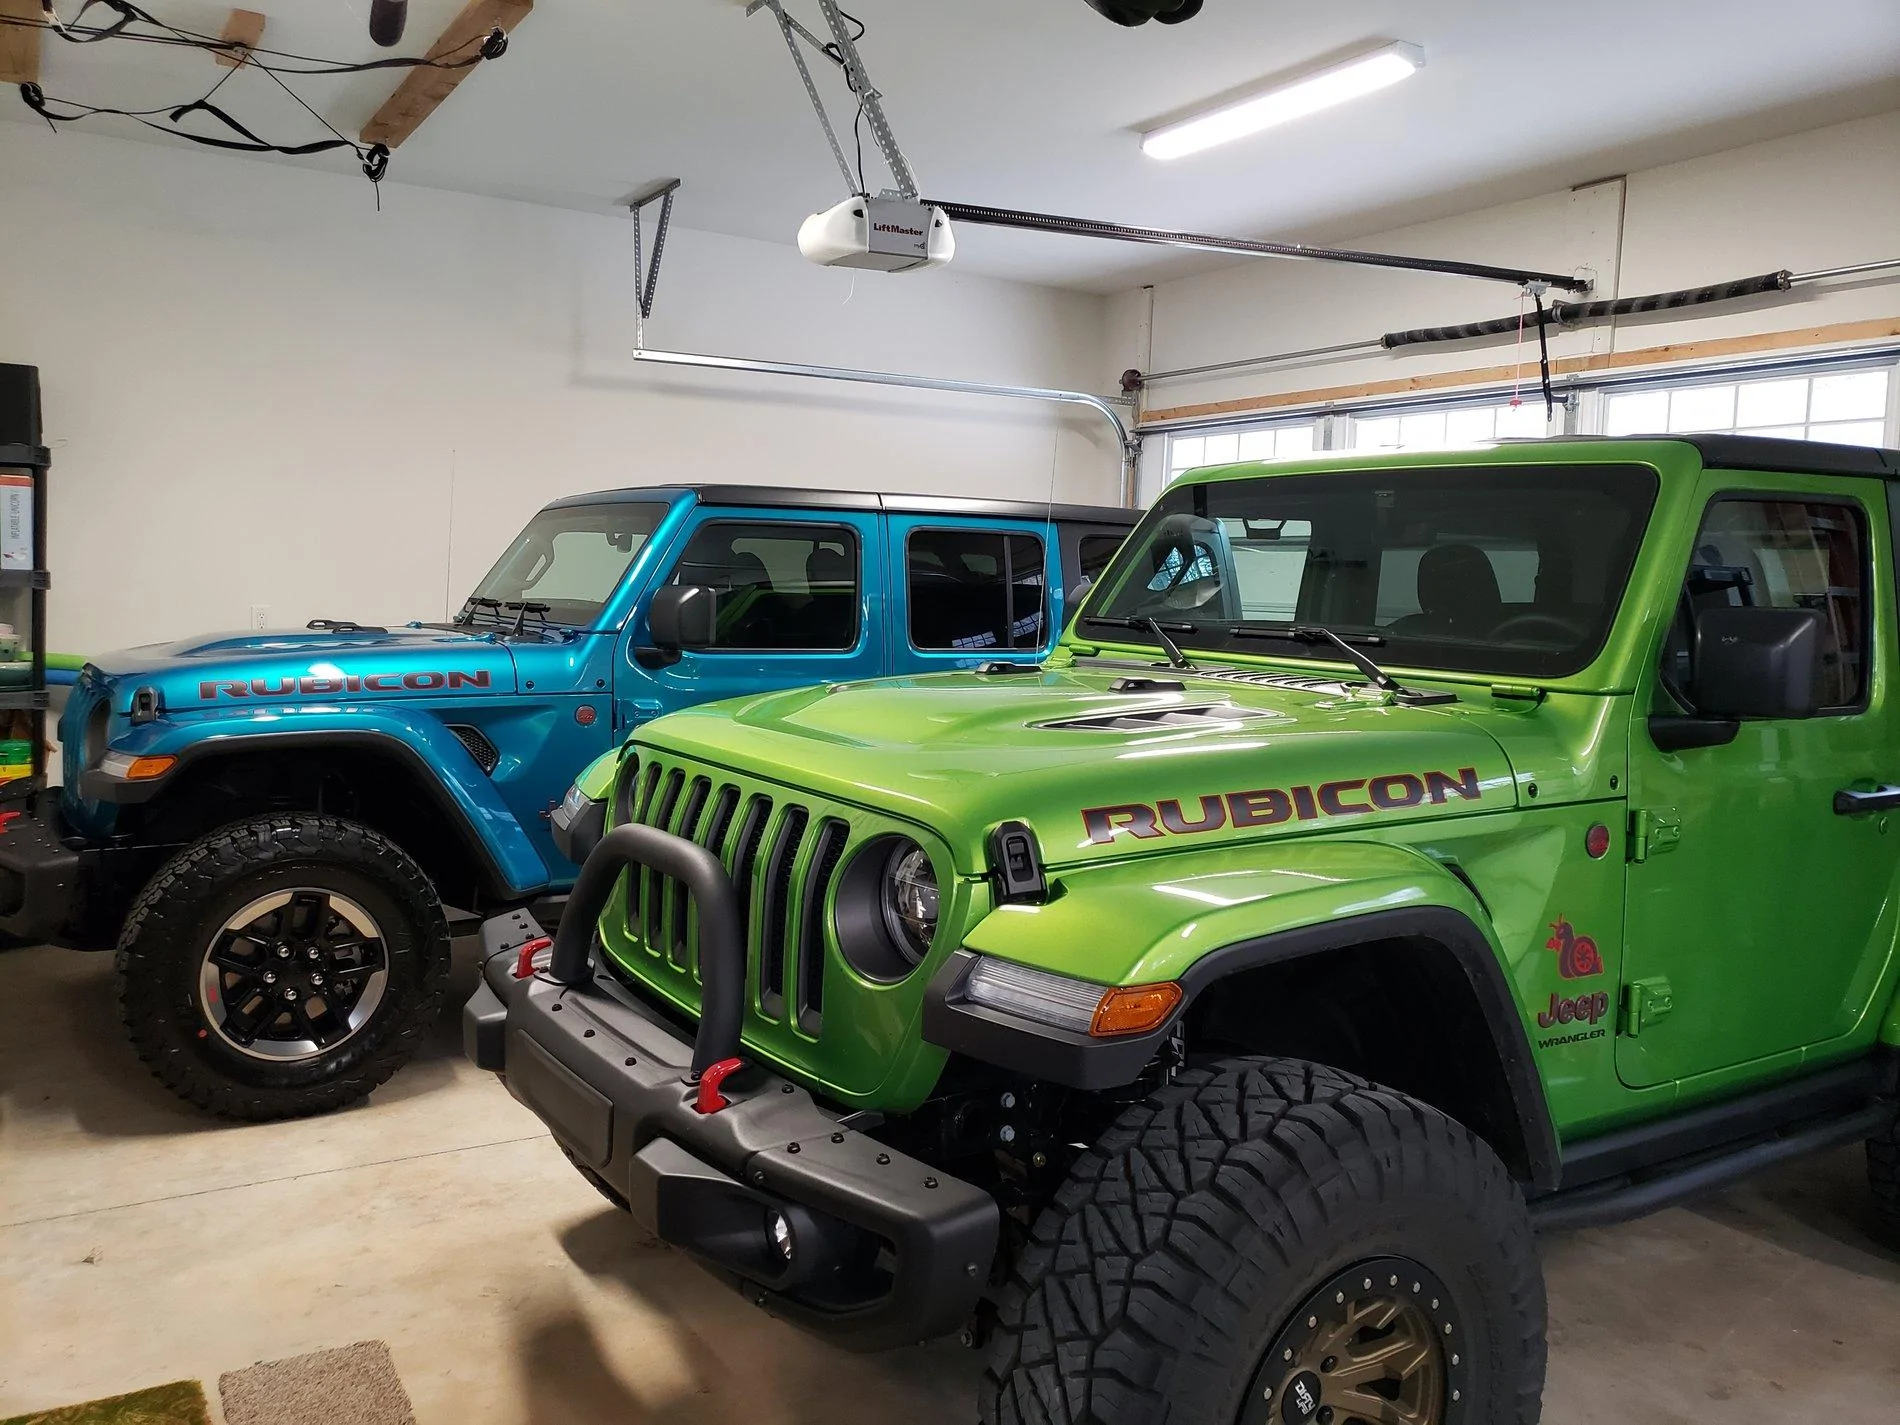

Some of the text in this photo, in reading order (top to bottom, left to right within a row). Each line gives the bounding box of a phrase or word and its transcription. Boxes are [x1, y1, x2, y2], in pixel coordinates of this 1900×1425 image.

[873, 222, 923, 236] LiftMaster
[199, 670, 491, 700] RUBICON
[1081, 767, 1482, 845] RUBICON
[1537, 991, 1610, 1029] Jeep
[1538, 1028, 1606, 1050] WRANGLER
